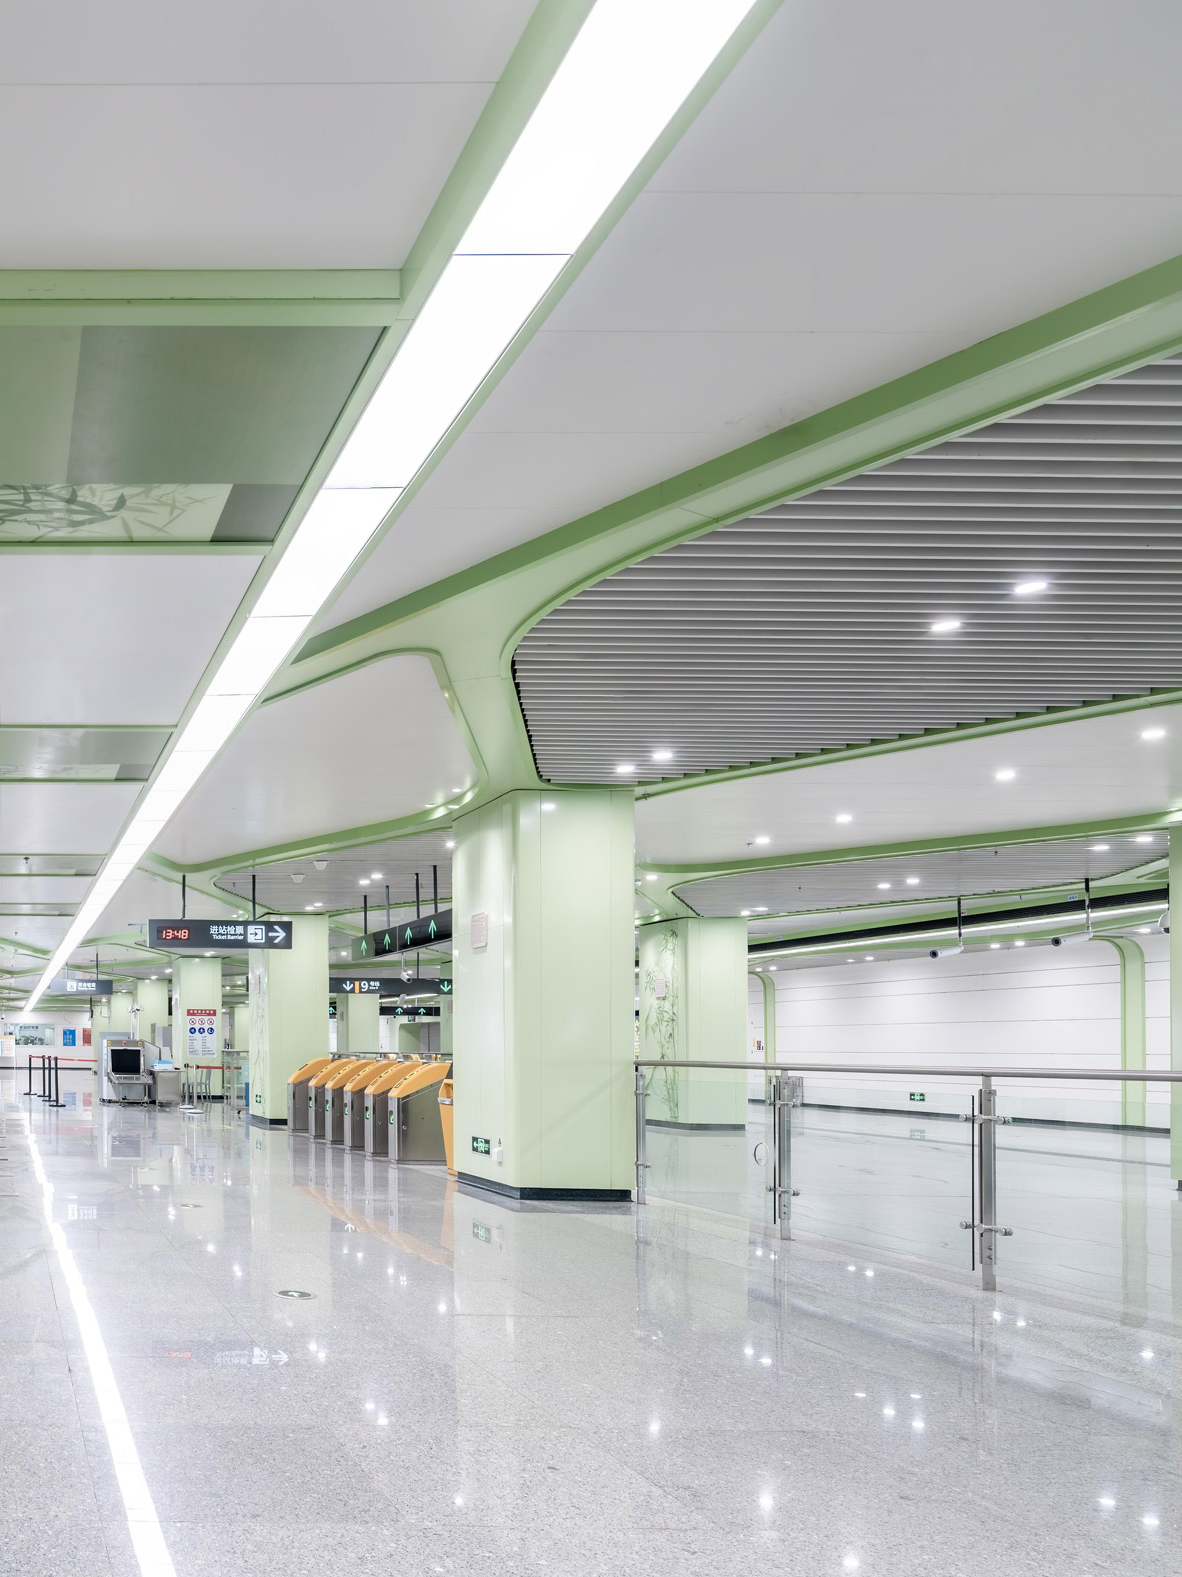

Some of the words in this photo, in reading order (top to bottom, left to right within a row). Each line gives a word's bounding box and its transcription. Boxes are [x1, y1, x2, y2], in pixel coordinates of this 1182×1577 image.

[162, 929, 189, 940] 13:48
[210, 925, 244, 934] 进站检票
[361, 981, 368, 991] 9
